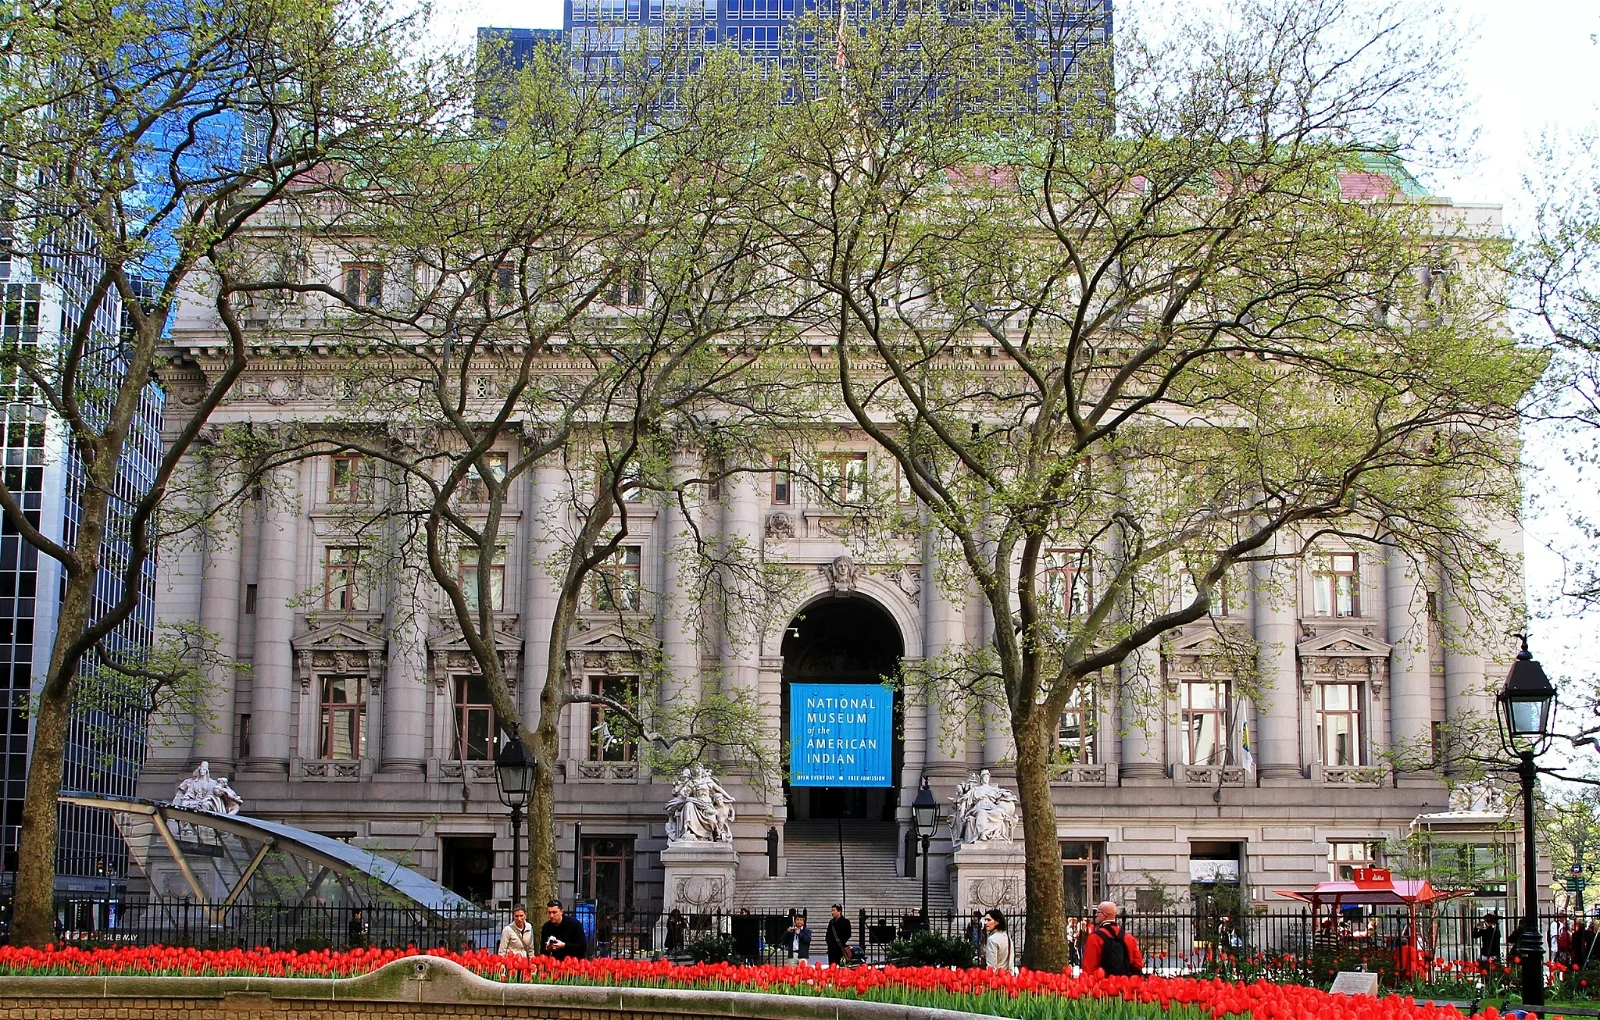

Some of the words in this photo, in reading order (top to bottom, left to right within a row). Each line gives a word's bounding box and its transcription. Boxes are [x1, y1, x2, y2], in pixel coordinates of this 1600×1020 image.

[807, 698, 876, 709] NATIONAL
[807, 713, 867, 724] MUSEUM
[807, 726, 816, 737] of
[817, 726, 830, 734] the
[807, 739, 877, 750] AMERICAN
[807, 754, 855, 764] INDIAN
